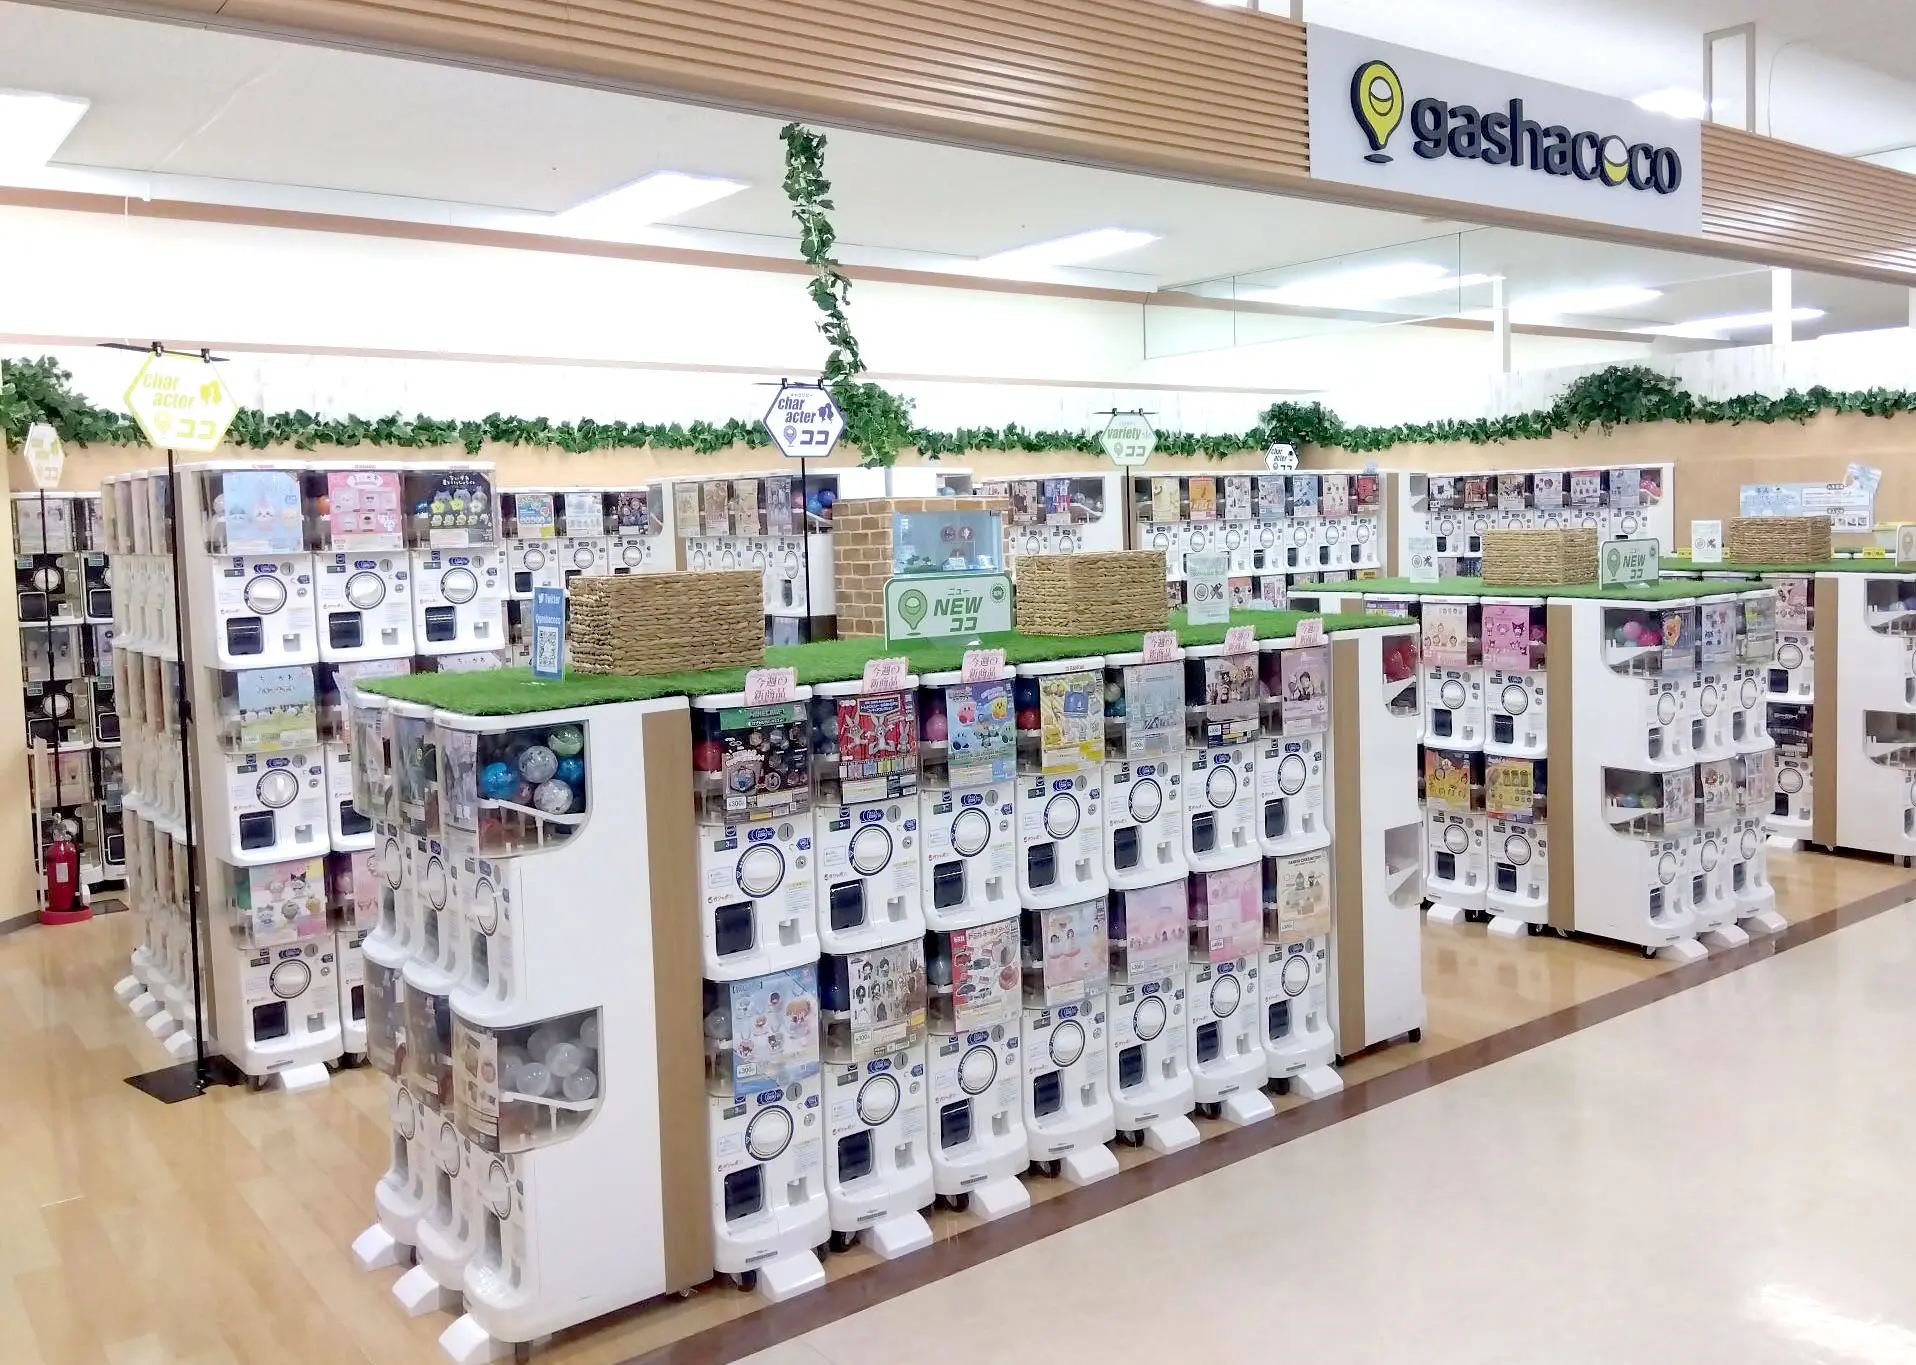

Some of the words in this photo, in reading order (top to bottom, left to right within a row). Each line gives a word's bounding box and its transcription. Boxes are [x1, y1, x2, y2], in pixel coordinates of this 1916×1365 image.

[1411, 98, 1682, 195] gashacoco
[777, 396, 806, 411] char
[785, 410, 817, 424] acter
[176, 418, 216, 439] ココ
[1107, 427, 1142, 440] variety
[799, 429, 830, 446] ココ
[1125, 445, 1146, 457] ココ
[1622, 554, 1646, 568] NEW
[933, 596, 984, 617] NEW
[949, 616, 978, 633] ココ
[873, 664, 901, 677] 今週の
[756, 676, 788, 689] 今週の
